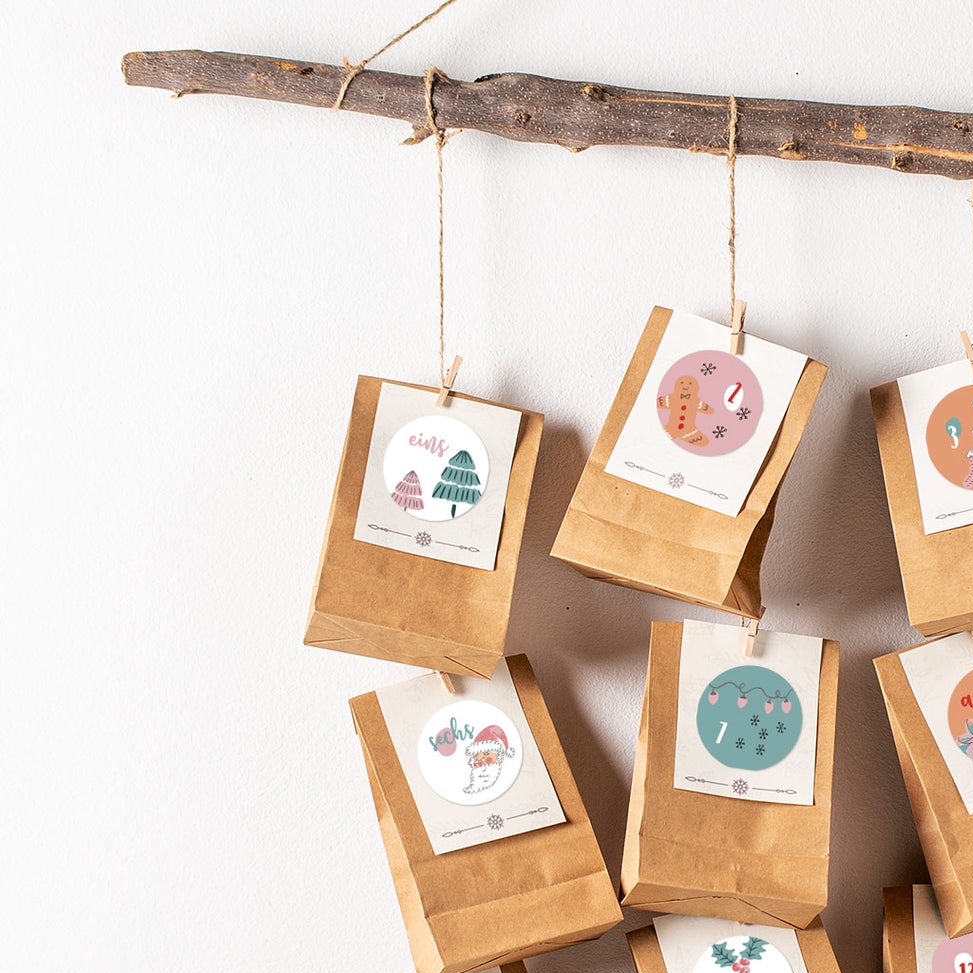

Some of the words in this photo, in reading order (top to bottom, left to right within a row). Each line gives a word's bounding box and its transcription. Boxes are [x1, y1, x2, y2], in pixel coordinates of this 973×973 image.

[409, 433, 449, 459] eins
[950, 426, 959, 448] 3
[429, 717, 474, 752] sechs
[716, 721, 728, 744] 7
